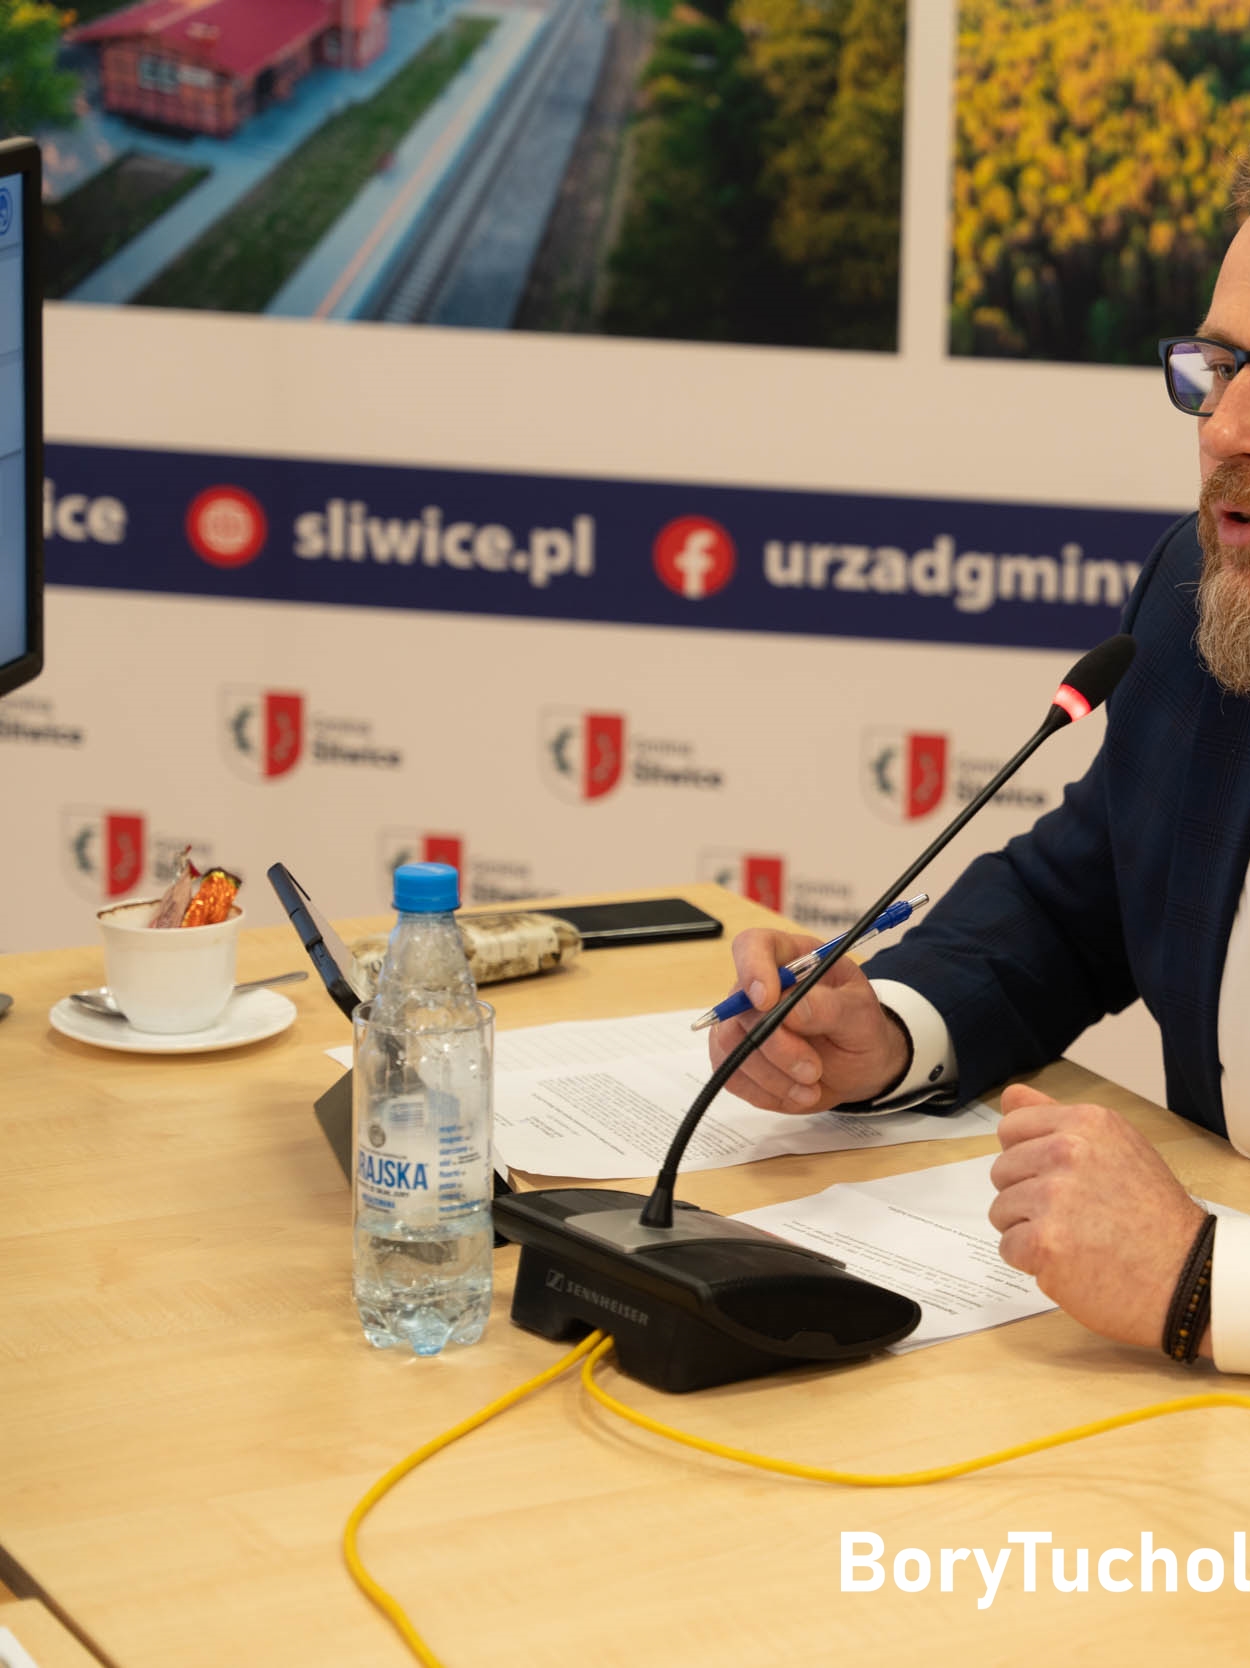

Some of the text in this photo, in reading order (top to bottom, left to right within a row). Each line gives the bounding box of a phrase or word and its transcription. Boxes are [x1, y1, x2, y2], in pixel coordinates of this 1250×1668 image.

[293, 499, 594, 588] sliwice.pl
[764, 534, 1140, 613] urzadgmin
[566, 1280, 649, 1327] SENNHEISER
